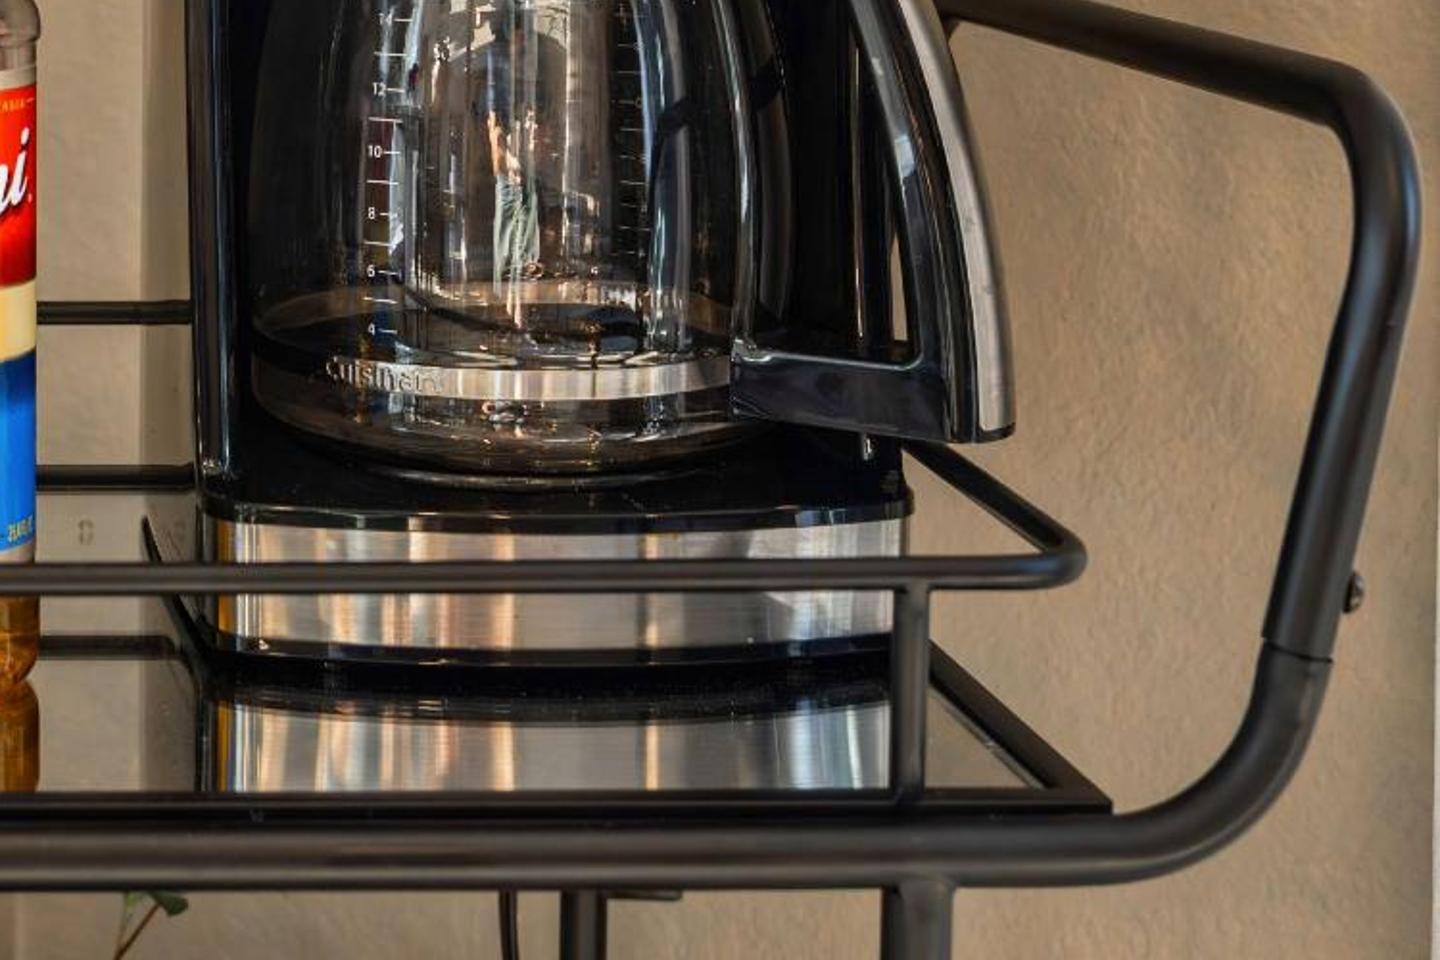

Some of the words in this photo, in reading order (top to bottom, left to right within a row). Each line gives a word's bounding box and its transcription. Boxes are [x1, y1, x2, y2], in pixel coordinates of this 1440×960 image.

[372, 81, 386, 96] 12
[368, 144, 382, 158] 10
[367, 206, 375, 220] 8
[366, 264, 376, 278] 6
[367, 322, 376, 336] 4
